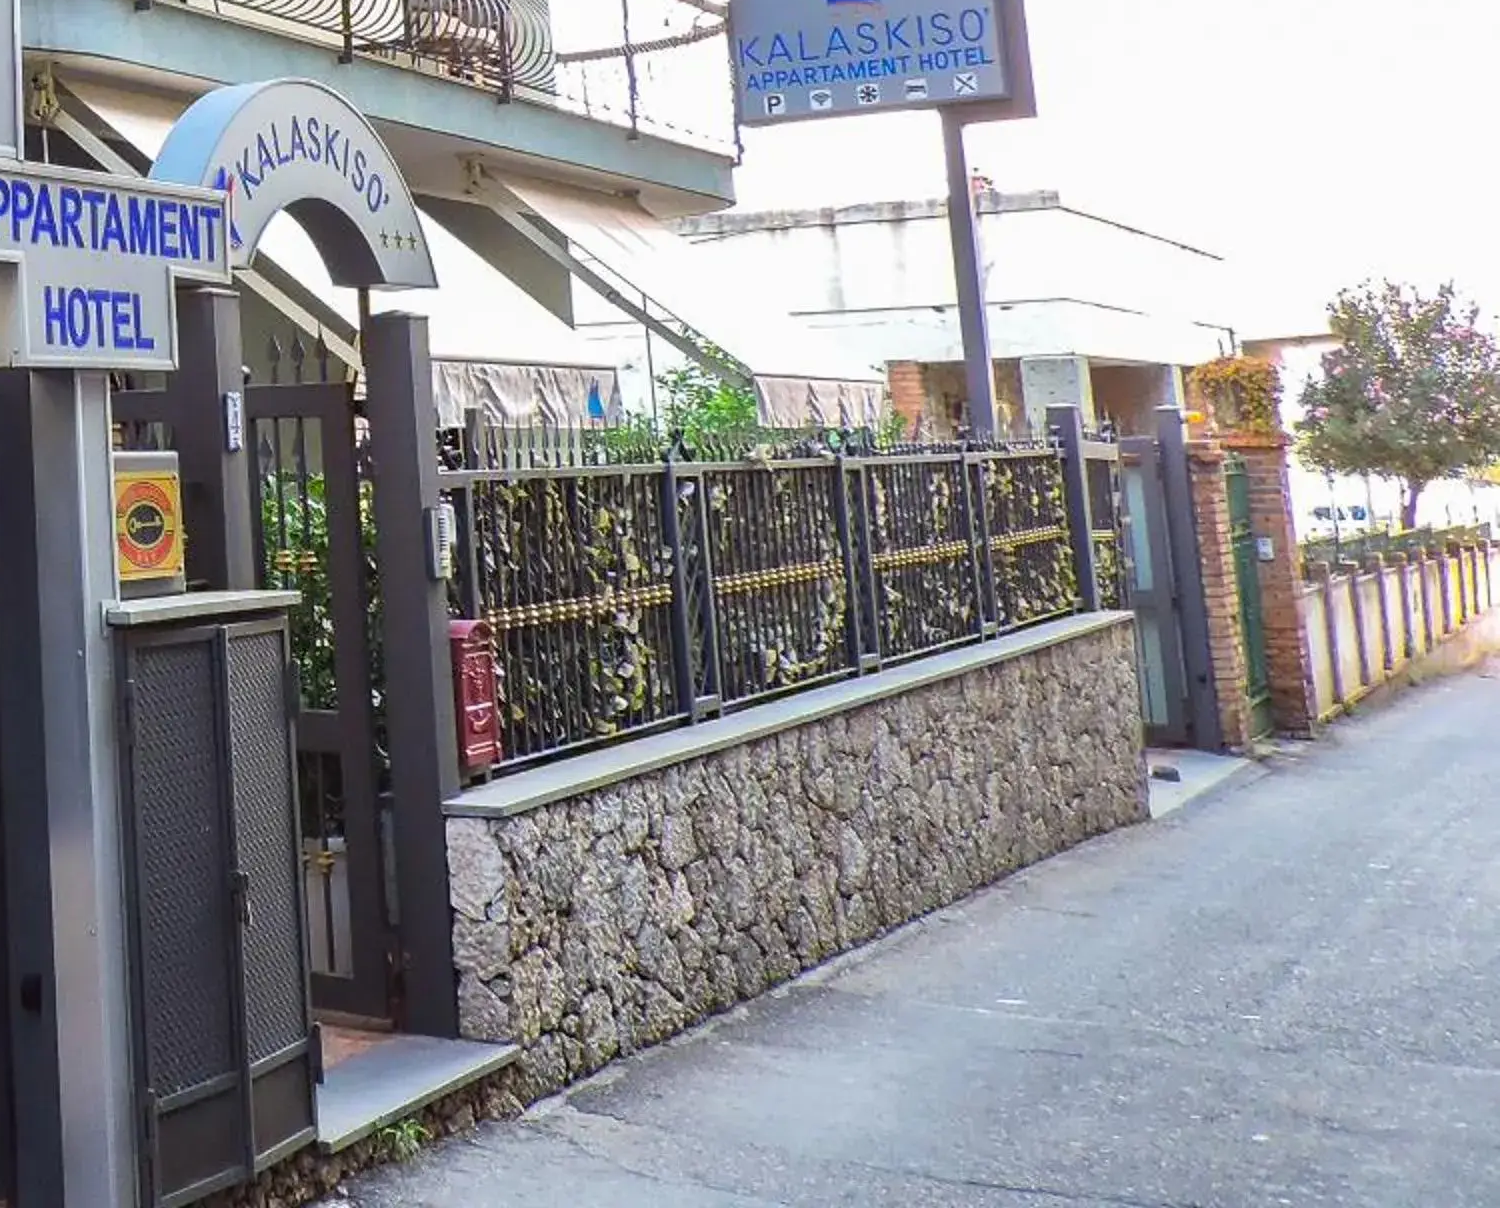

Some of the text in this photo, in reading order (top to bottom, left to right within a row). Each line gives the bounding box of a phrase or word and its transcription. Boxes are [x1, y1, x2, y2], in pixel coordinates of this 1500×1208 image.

[738, 7, 990, 68] KALASKISO'
[745, 45, 995, 92] APPARTAMENT HOTEL
[44, 285, 155, 352] HOTEL
